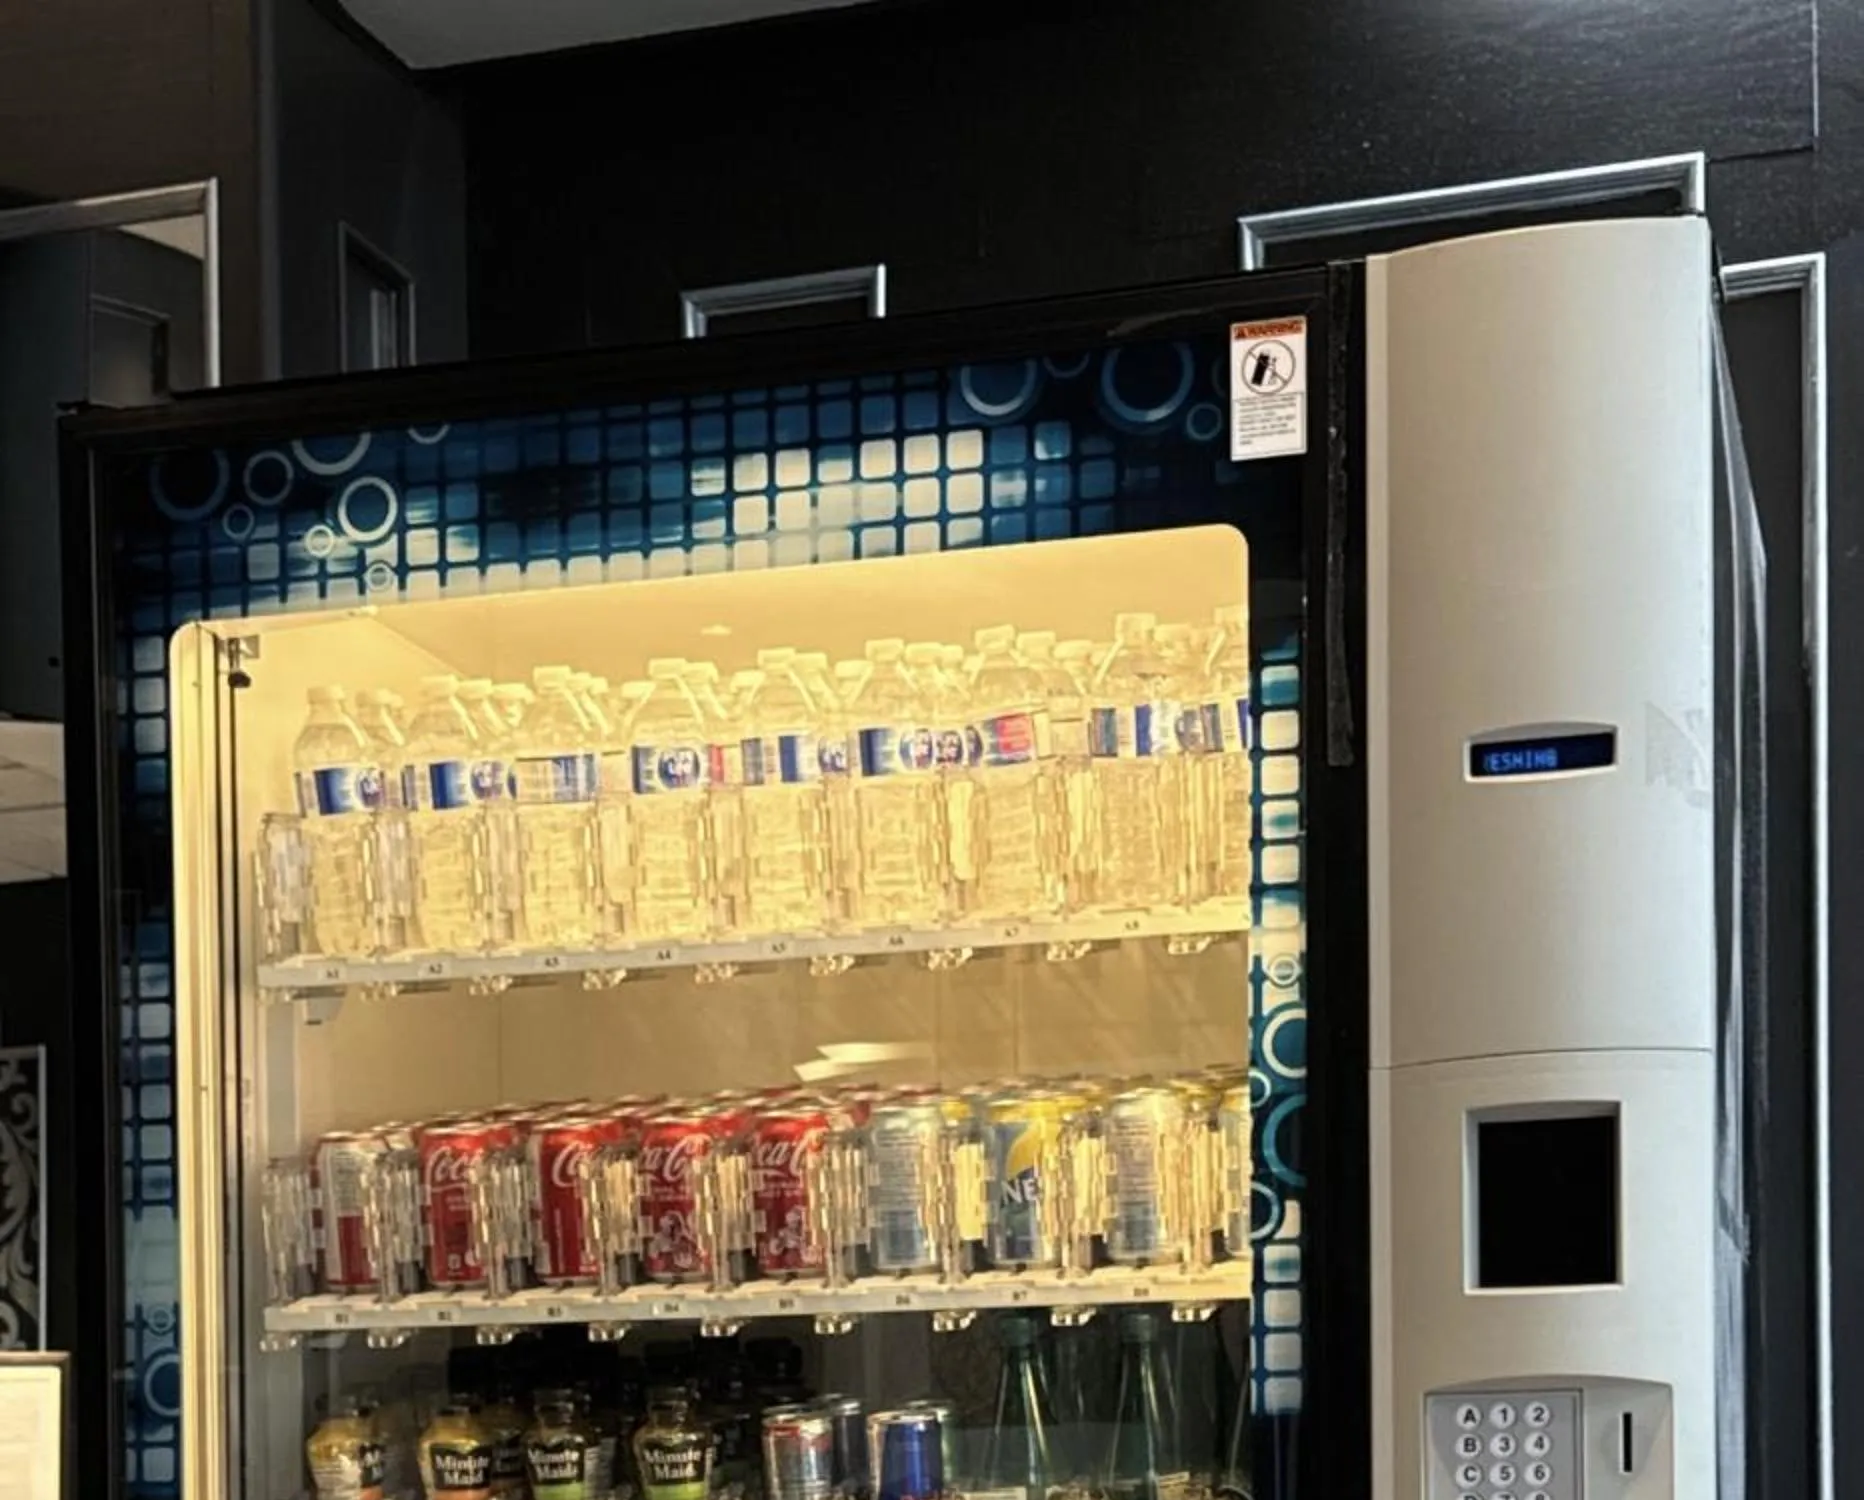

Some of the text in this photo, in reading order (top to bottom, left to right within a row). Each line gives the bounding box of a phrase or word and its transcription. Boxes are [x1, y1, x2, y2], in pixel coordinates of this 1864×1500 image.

[1464, 1407, 1545, 1424] A 1 2
[1464, 1436, 1544, 1452] B 3 4
[1464, 1465, 1545, 1482] C 5 6
